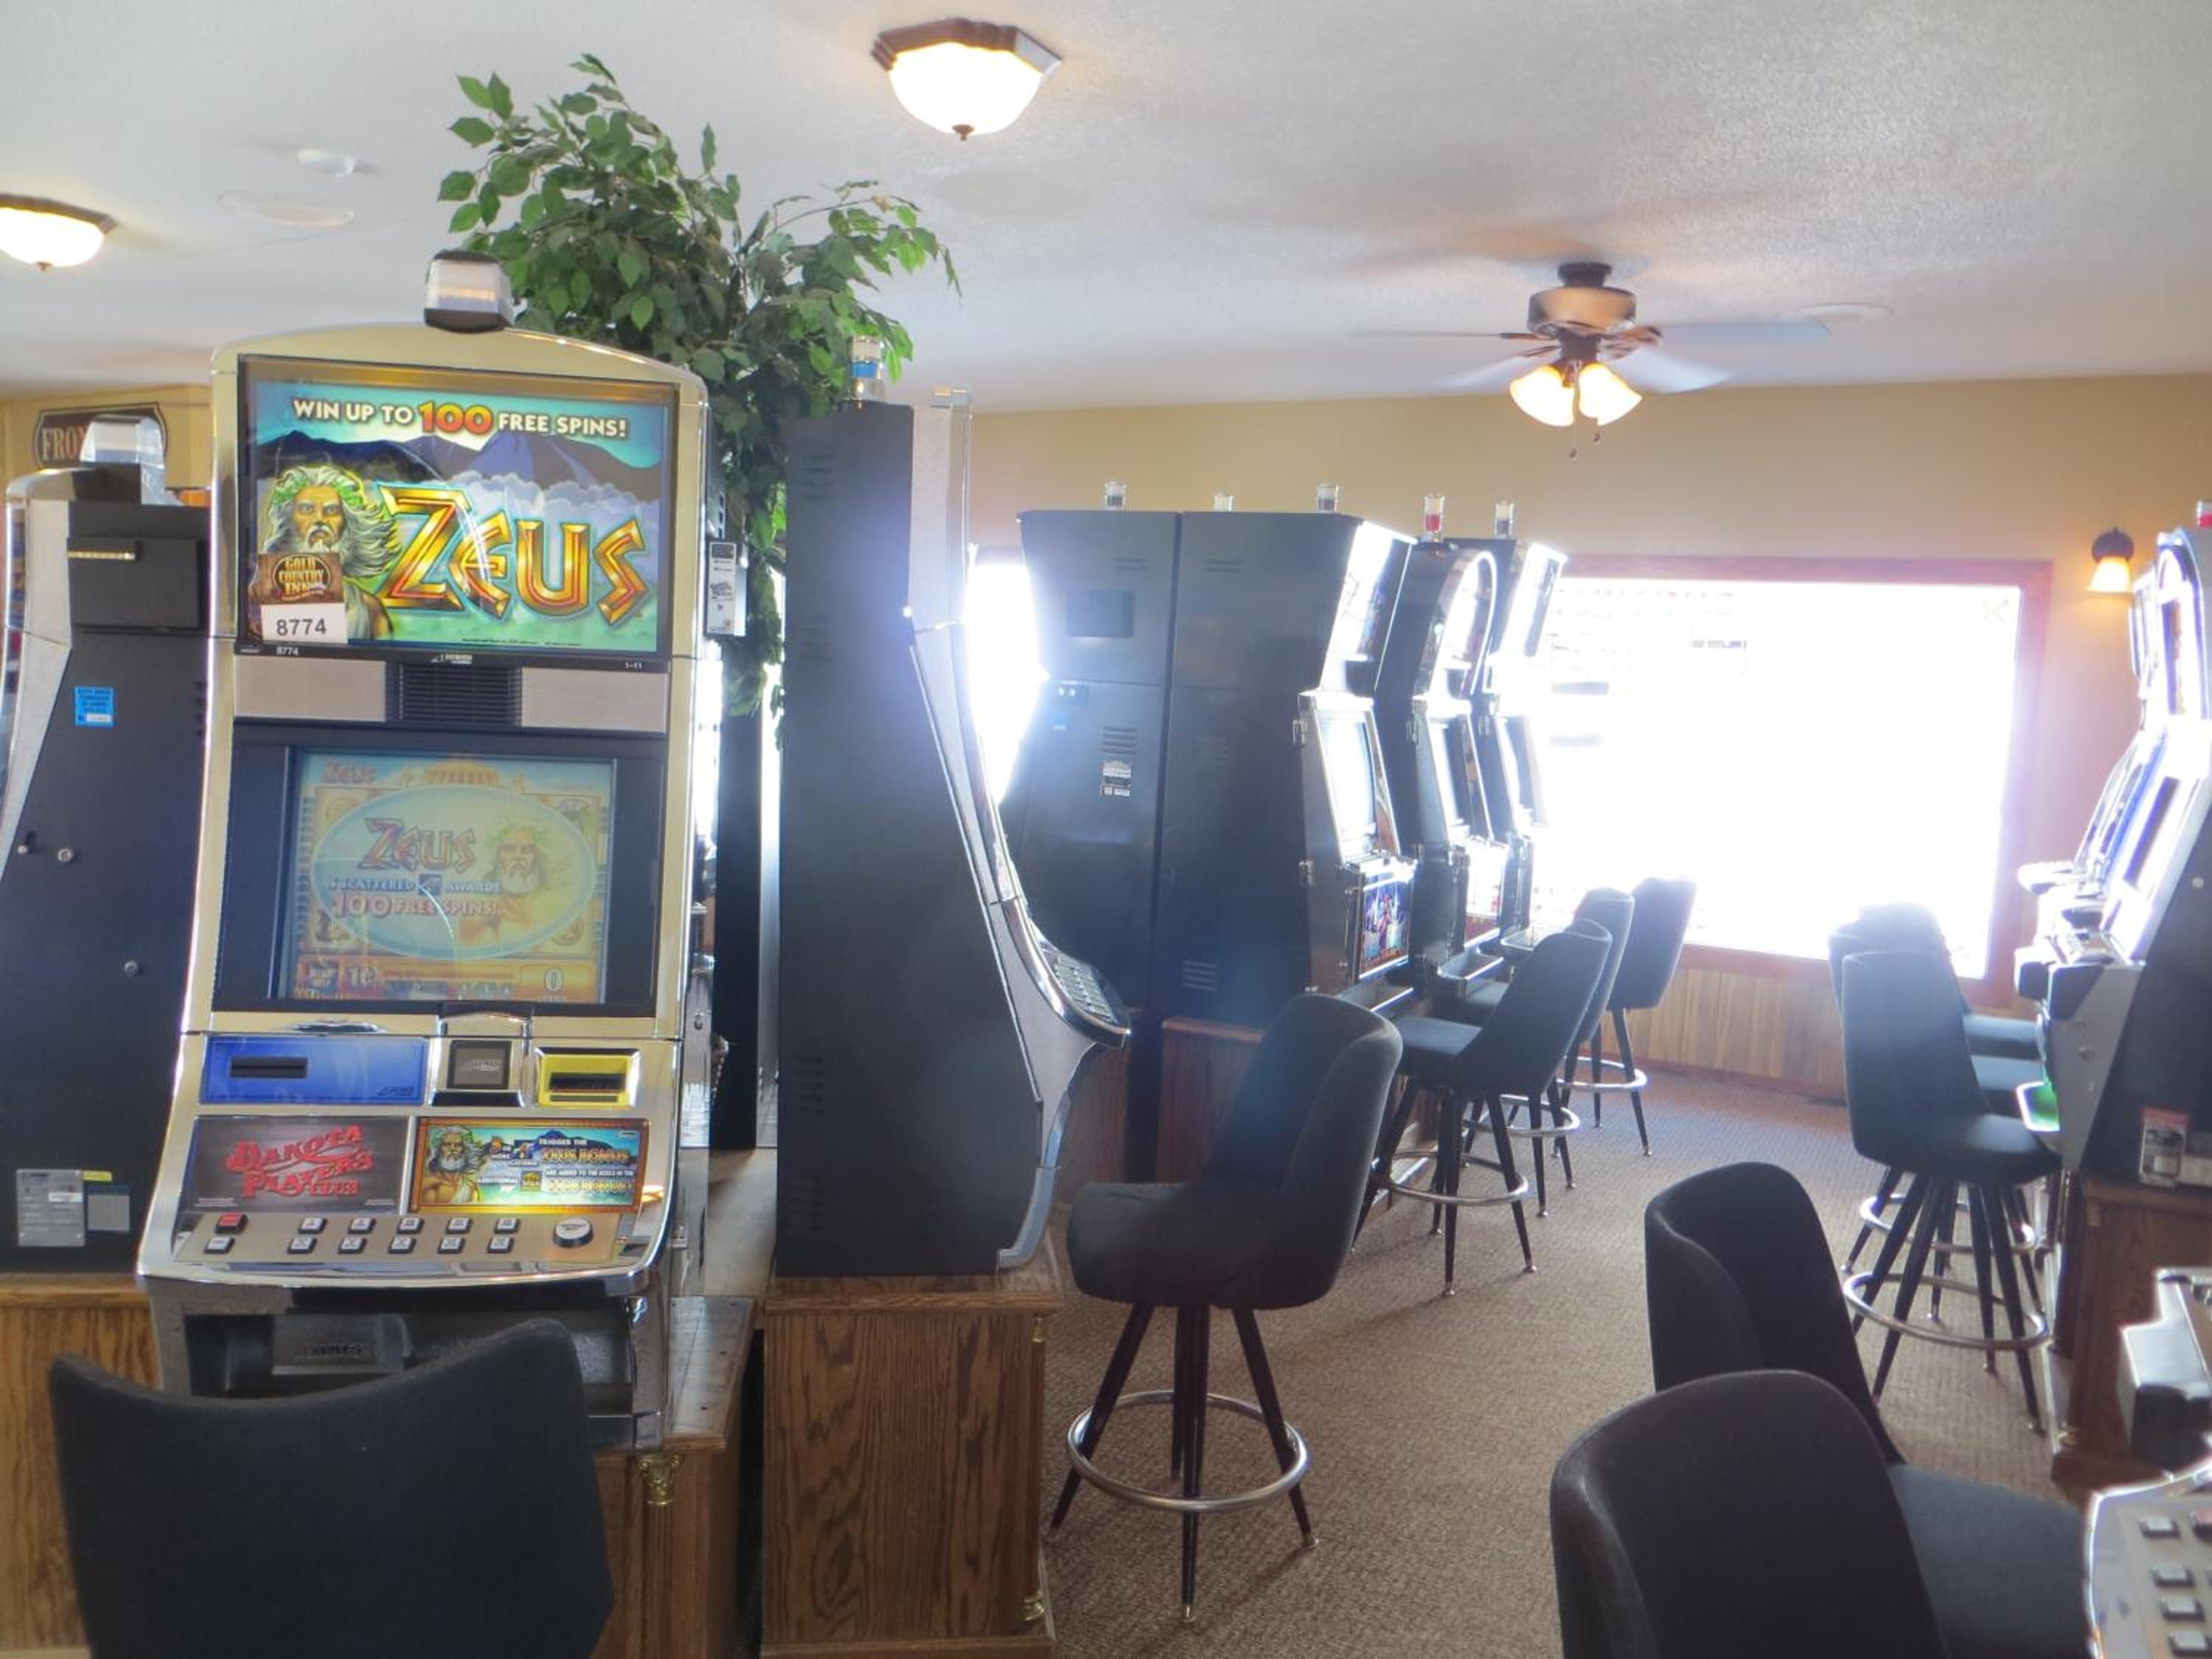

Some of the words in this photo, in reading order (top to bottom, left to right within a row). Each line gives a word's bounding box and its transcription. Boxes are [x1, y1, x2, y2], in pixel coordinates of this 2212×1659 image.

[293, 400, 339, 421] WIN
[346, 403, 374, 422] UP
[382, 405, 413, 424] TO
[419, 402, 493, 435] 100
[498, 412, 549, 433] FREE
[556, 415, 627, 437] SPINS!
[285, 557, 316, 570] GOLD
[278, 570, 324, 582] COUNTRY
[276, 619, 327, 636] 8774
[276, 647, 299, 655] 8774
[333, 892, 392, 919] 100
